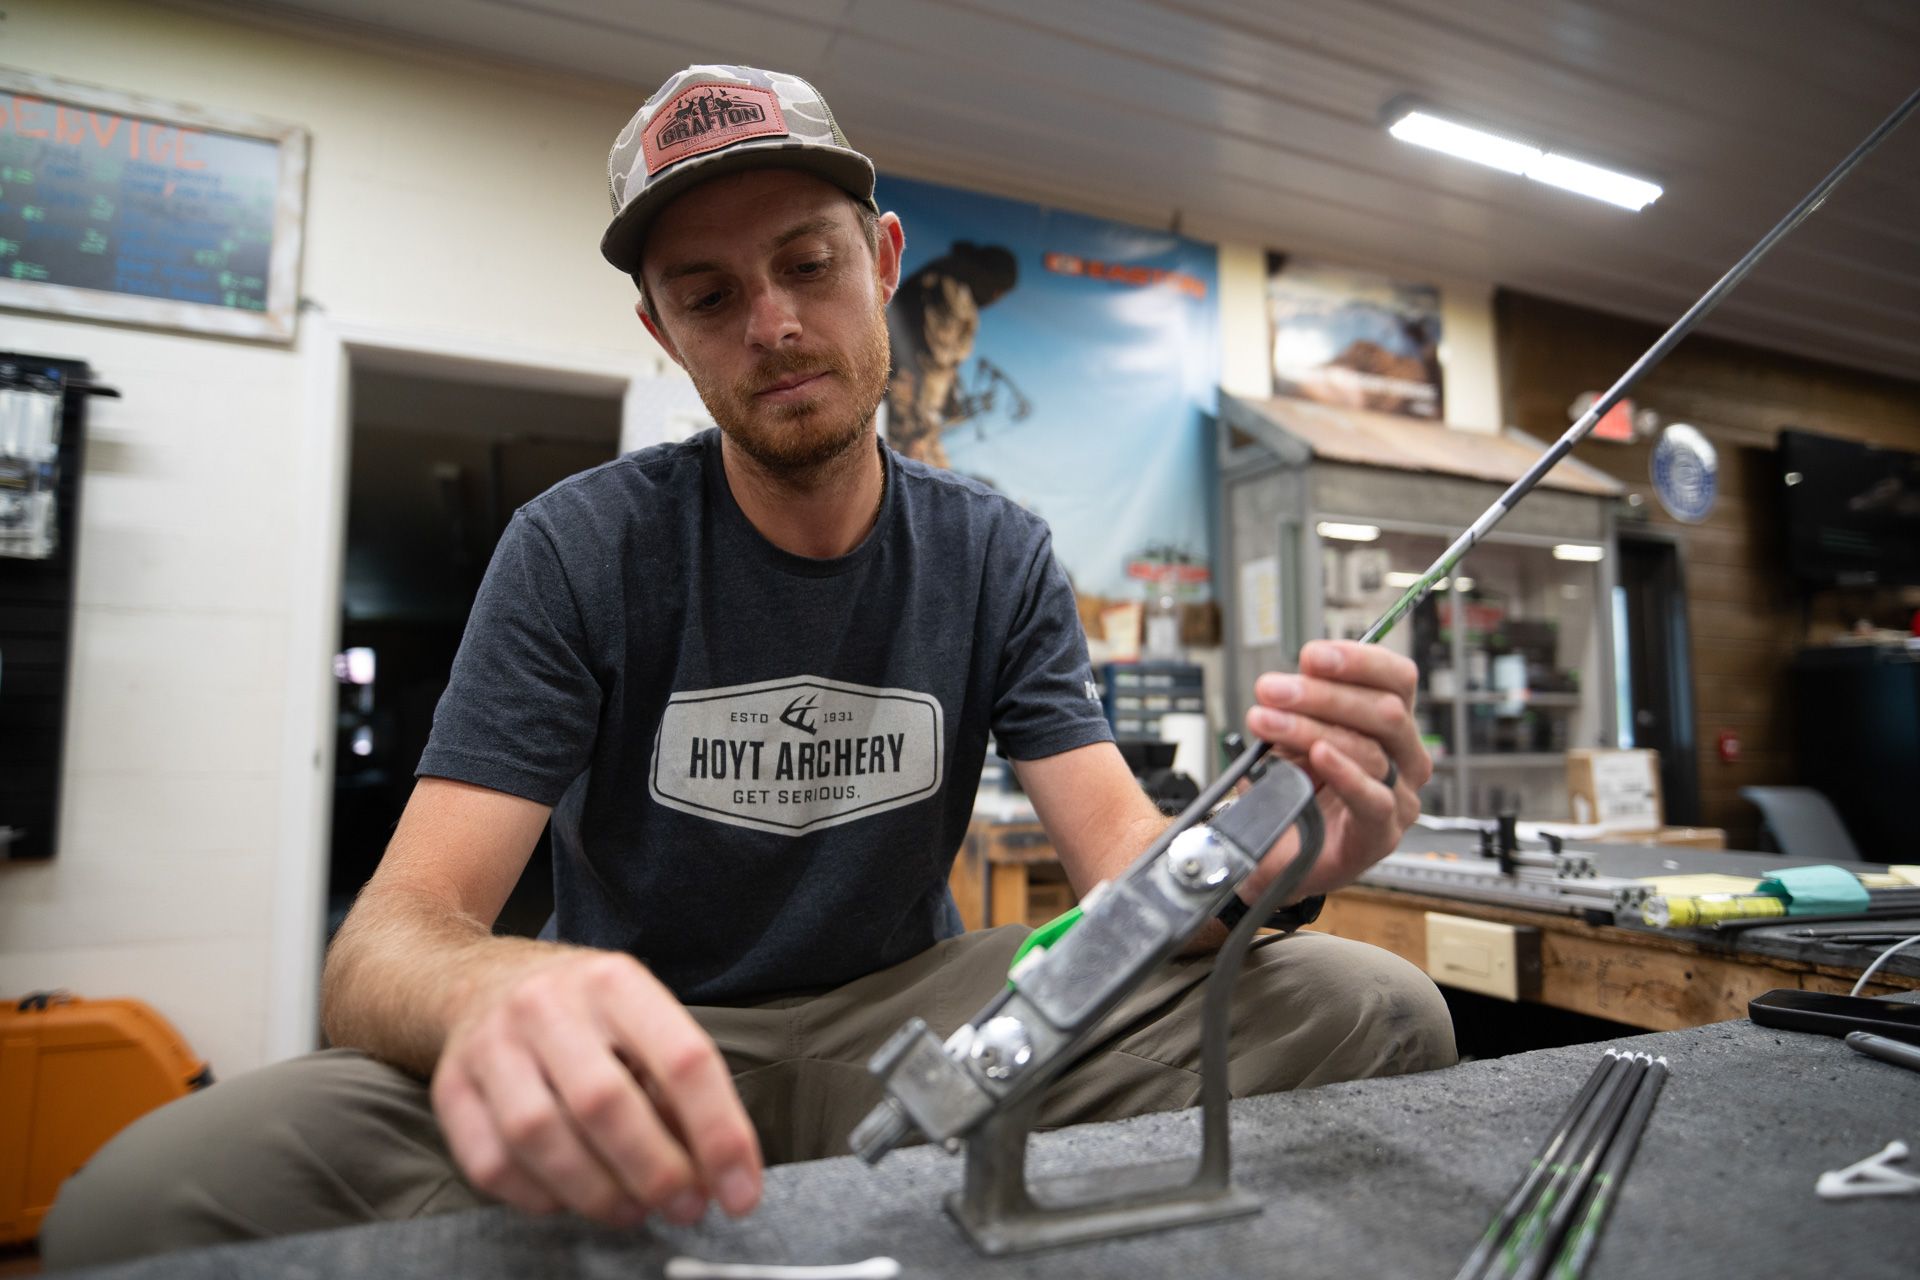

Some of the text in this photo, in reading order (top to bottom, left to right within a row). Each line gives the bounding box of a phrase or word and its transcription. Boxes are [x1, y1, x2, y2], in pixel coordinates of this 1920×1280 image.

[661, 107, 760, 145] GRAFTON
[730, 711, 854, 724] ESTD 1931
[689, 732, 905, 781] HOYT ARCHERY
[733, 785, 861, 804] GET SERIOUS.
